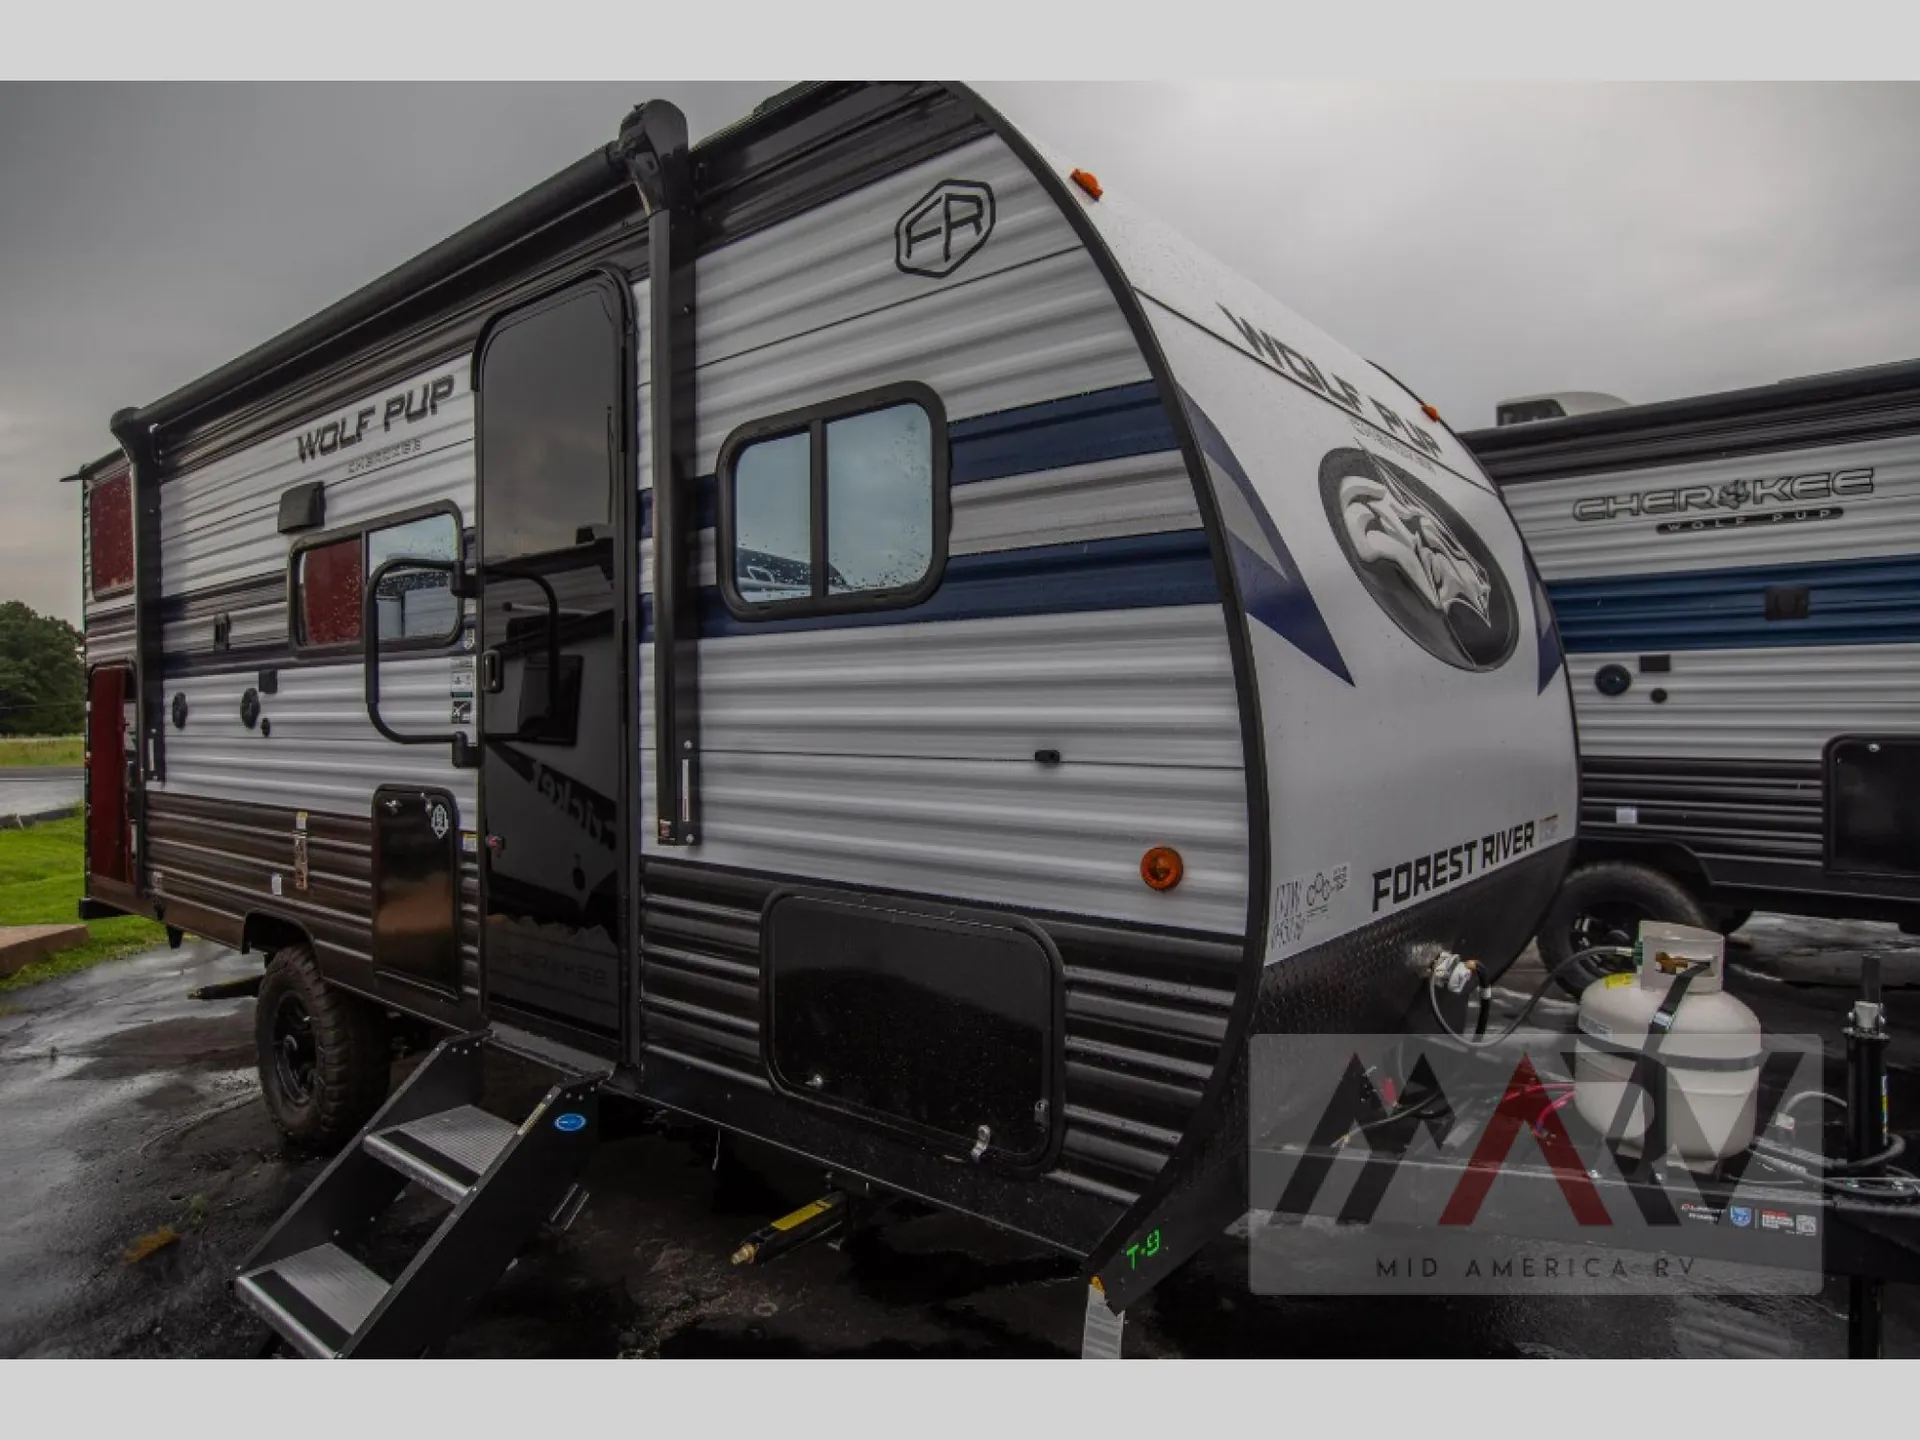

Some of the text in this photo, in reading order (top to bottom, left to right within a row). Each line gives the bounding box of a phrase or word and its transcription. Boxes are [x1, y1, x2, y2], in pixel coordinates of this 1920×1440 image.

[1215, 301, 1362, 413] WOLF
[297, 374, 455, 463] WOLF PUP
[1667, 509, 1832, 532] WOLF PUP
[1372, 839, 1478, 913] FOREST
[1481, 820, 1535, 868] RIVER
